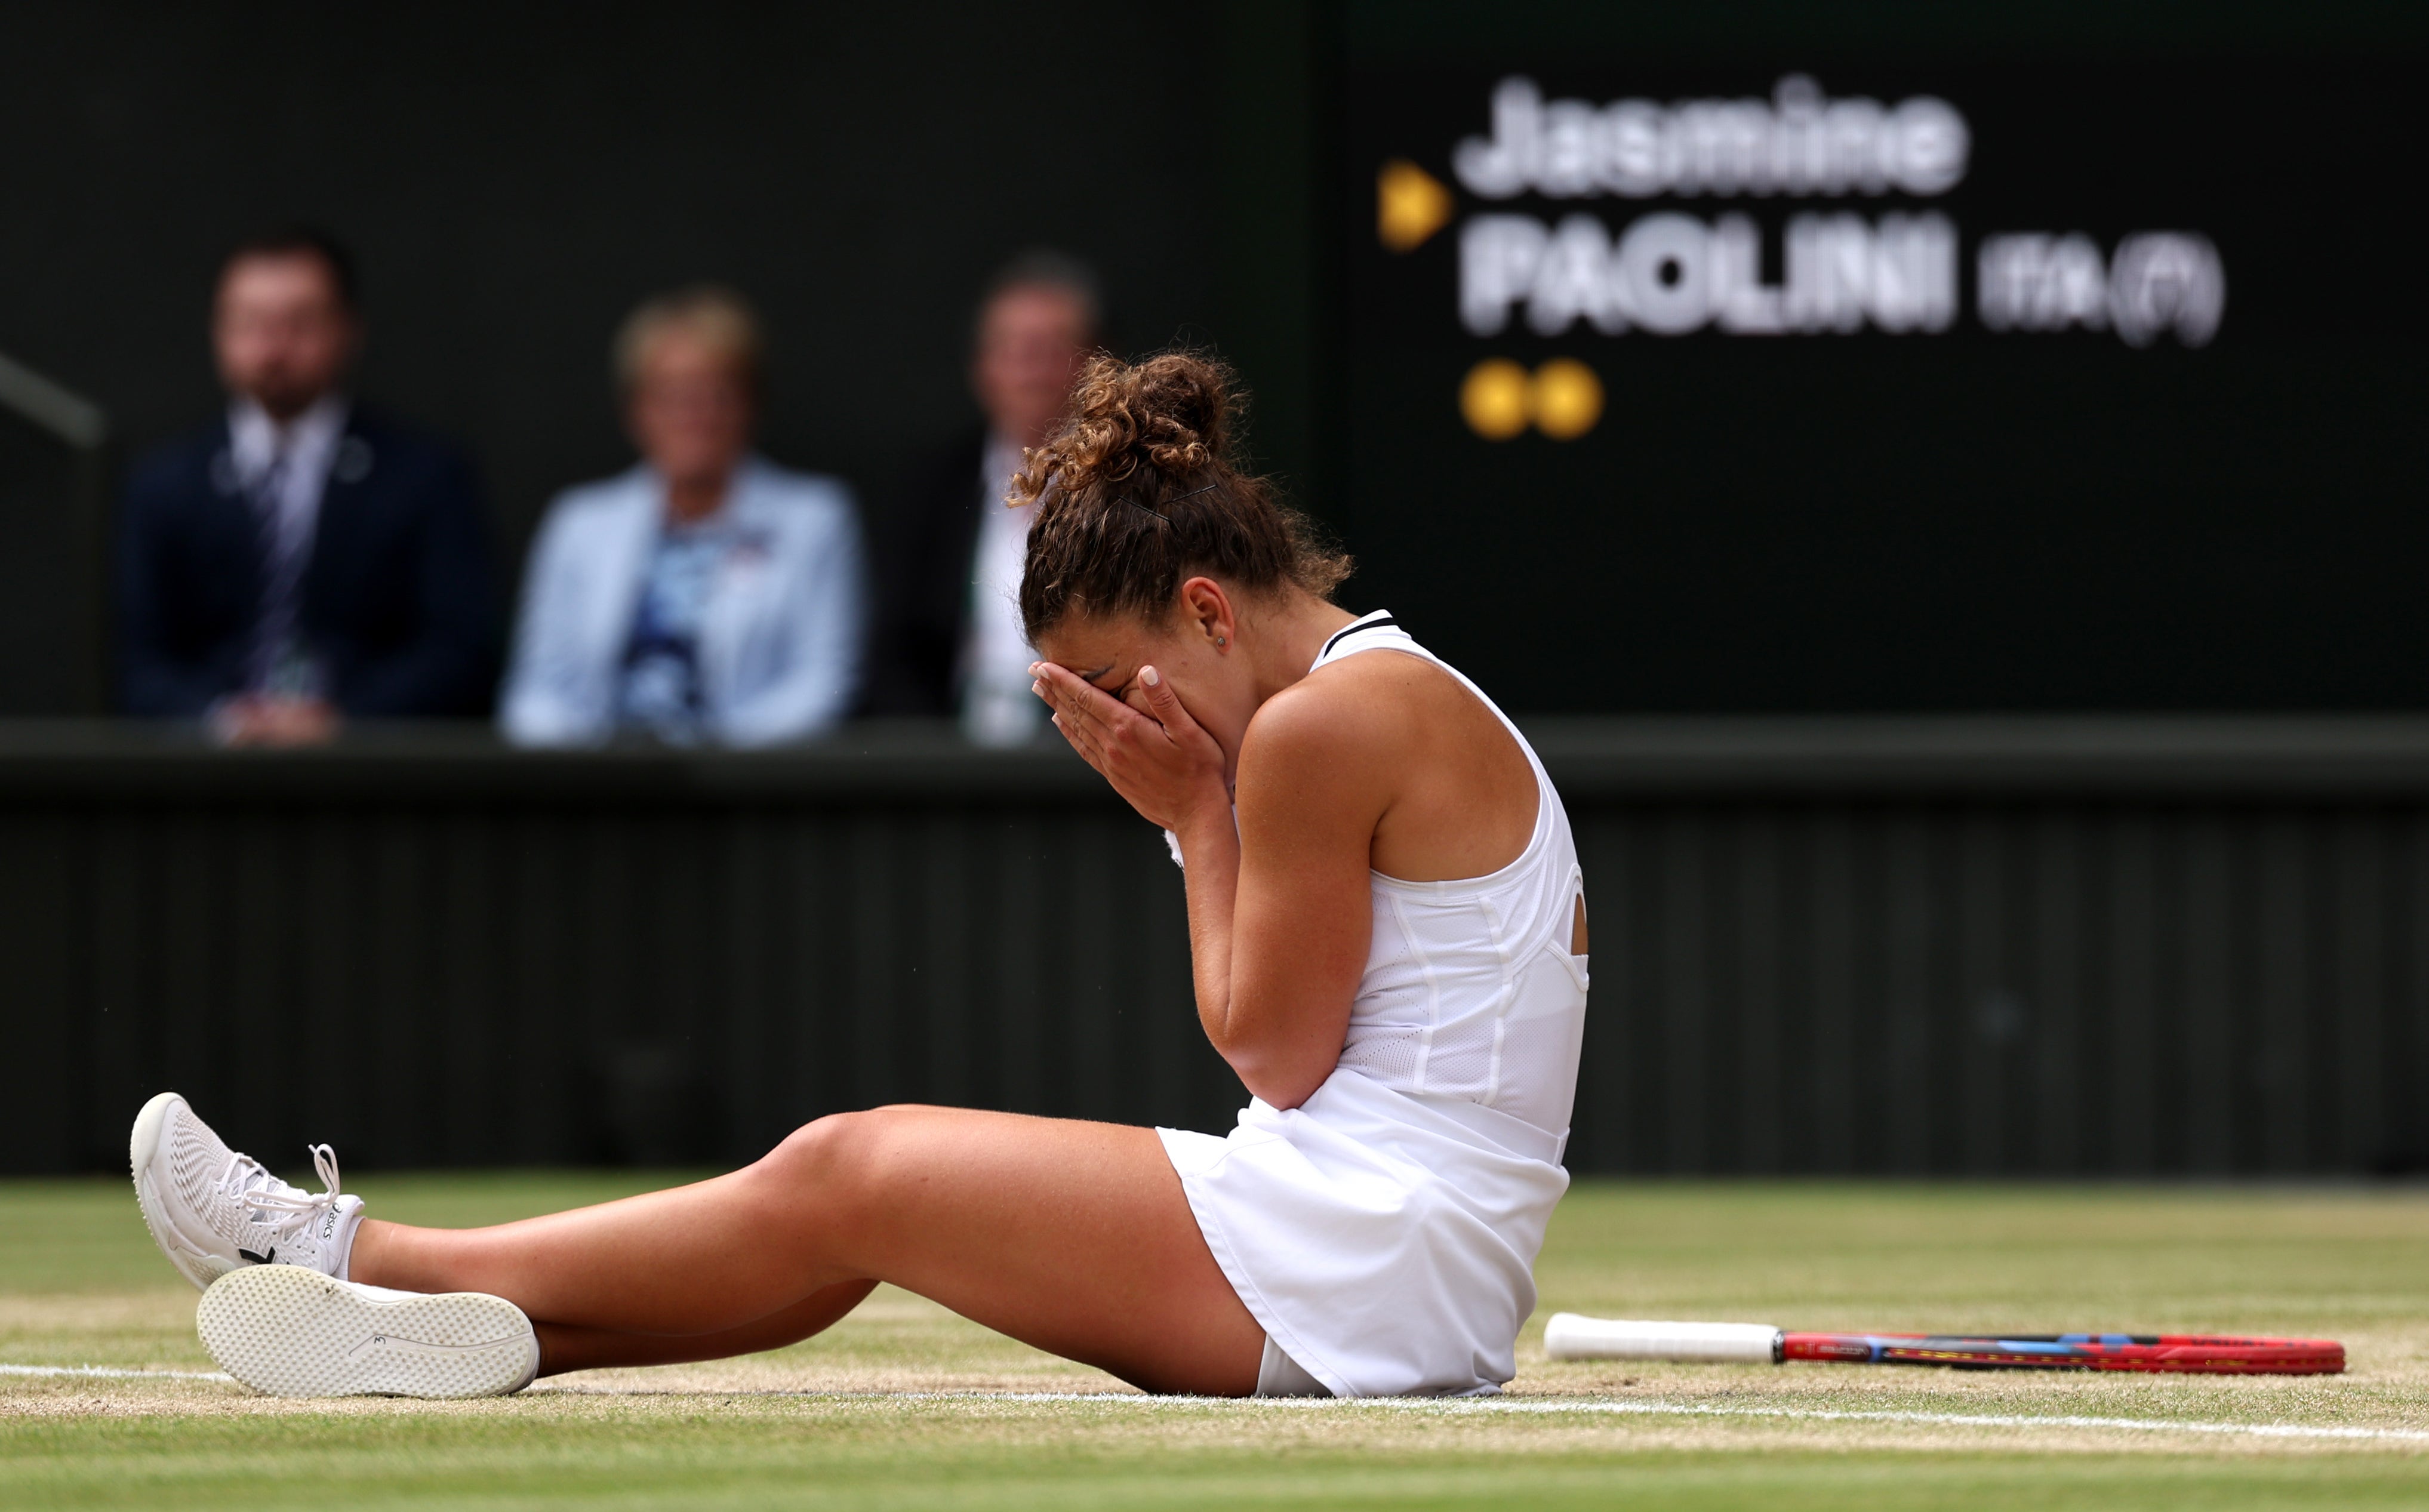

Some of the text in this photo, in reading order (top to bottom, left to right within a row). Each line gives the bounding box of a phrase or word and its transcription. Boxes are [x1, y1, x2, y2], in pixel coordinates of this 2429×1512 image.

[1455, 76, 1969, 197] Jasmine
[1460, 214, 1957, 334] PAOLINI
[1977, 232, 2107, 332] ITA
[323, 1212, 337, 1240] asics
